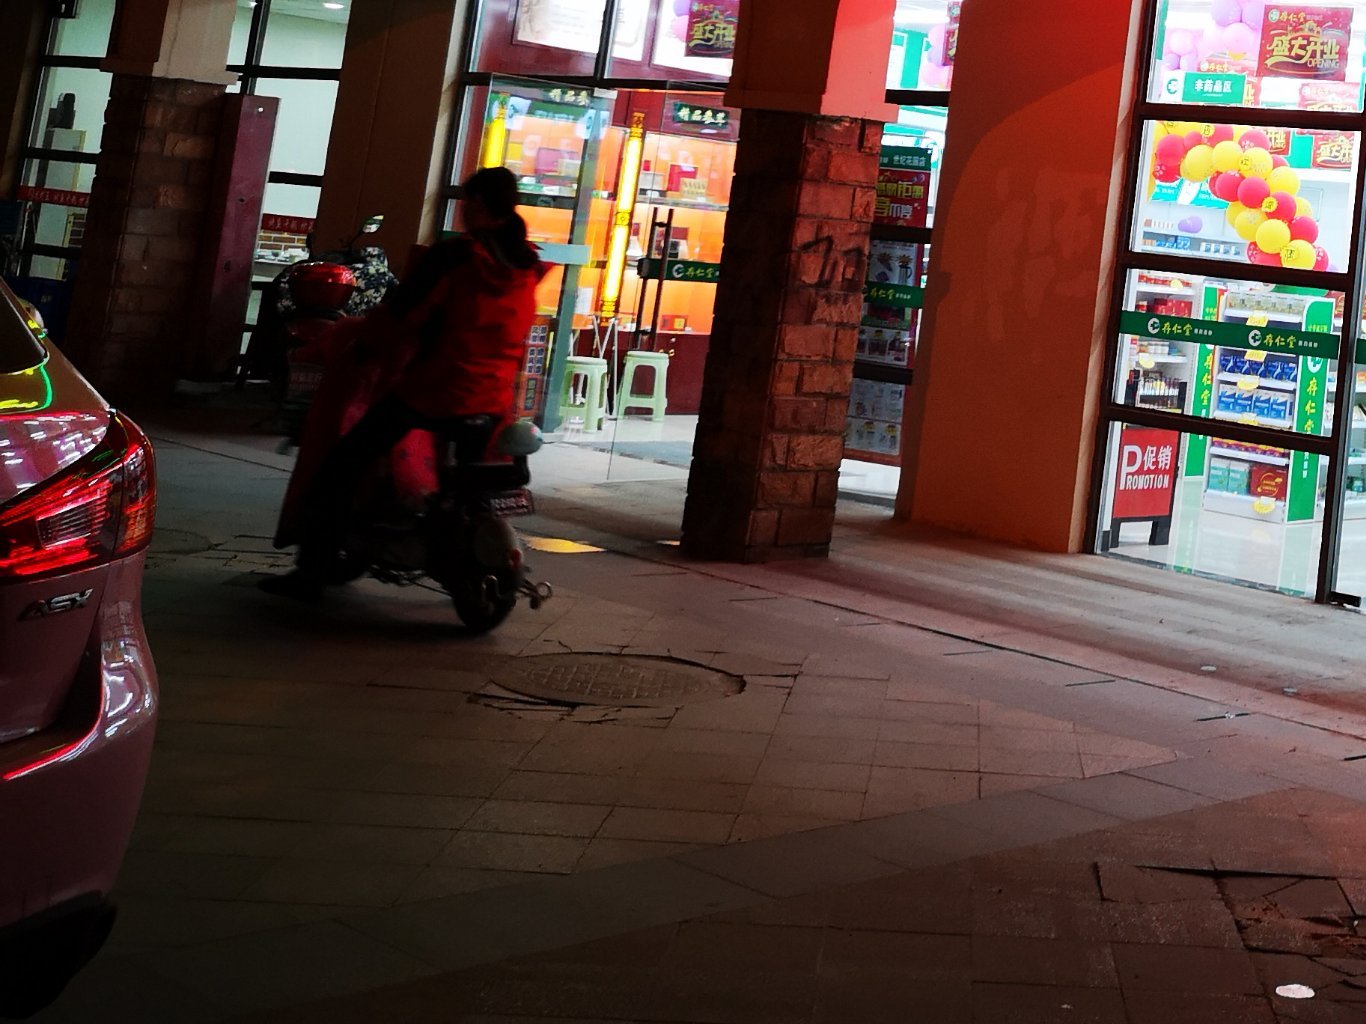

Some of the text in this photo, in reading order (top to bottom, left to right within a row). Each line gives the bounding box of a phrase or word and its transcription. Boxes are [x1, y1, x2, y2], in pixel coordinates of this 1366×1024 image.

[1267, 36, 1340, 61] 盛大开业
[1307, 59, 1340, 69] OPENING
[1161, 323, 1193, 336] 存仁堂
[1263, 333, 1297, 349] 存仁堂
[1119, 445, 1170, 491] PROMOTION
[1143, 445, 1173, 471] 促销
[18, 588, 93, 622] ASX
